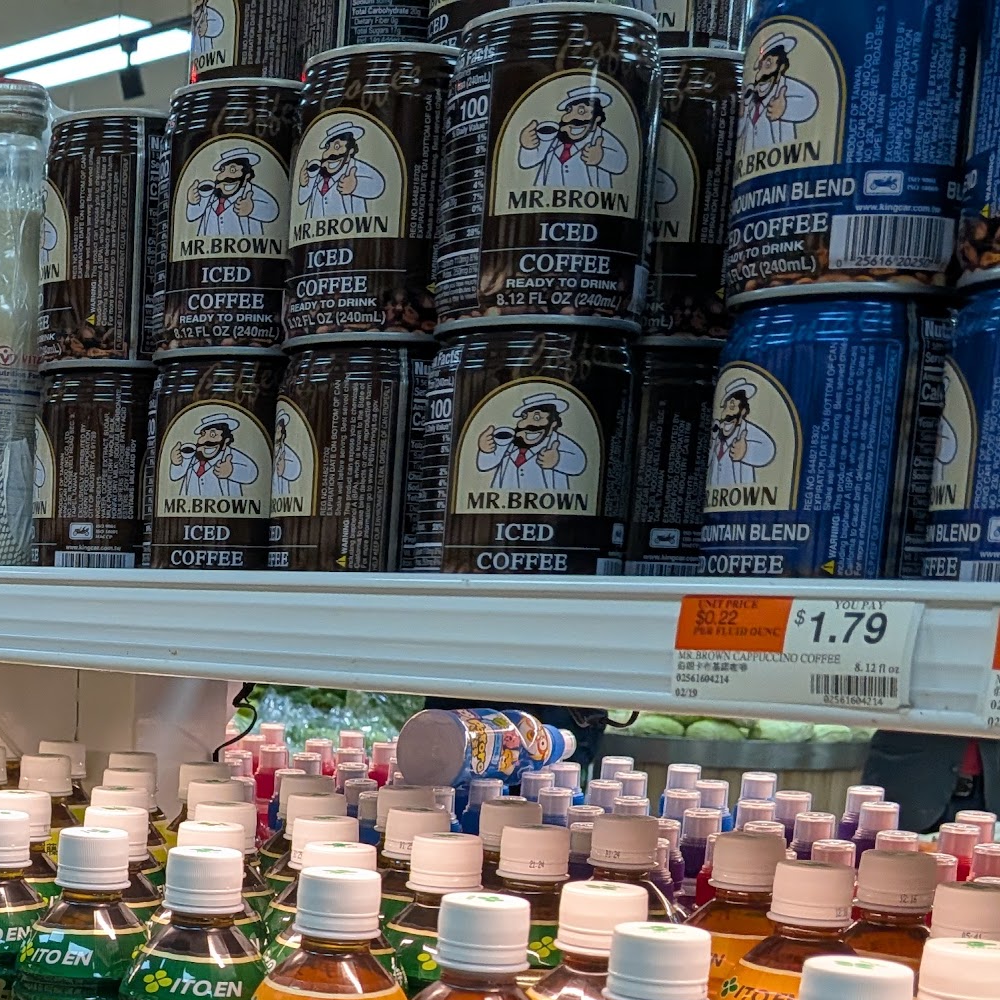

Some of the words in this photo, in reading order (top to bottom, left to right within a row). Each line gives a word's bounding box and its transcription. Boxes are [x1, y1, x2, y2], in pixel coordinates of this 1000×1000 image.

[460, 94, 488, 119] 100
[791, 177, 856, 200] BLEND
[508, 189, 630, 213] MR.BROWN
[293, 216, 388, 242] MR.BROWN
[539, 223, 599, 243] ICED
[743, 212, 829, 243] COFFEE
[179, 237, 283, 257] MR.BROWN
[745, 248, 760, 259] TO
[762, 240, 804, 255] DRINK
[307, 248, 354, 269] ICED
[519, 253, 611, 275] COFFEE
[200, 266, 251, 284] ICED
[742, 263, 758, 278] OZ
[296, 276, 368, 298] COFFEE
[506, 278, 554, 288] READY
[558, 279, 577, 288] TO
[580, 279, 618, 290] DRINK
[187, 292, 265, 310] COFFEE
[290, 301, 318, 313] READY
[320, 300, 335, 308] TO
[338, 298, 377, 307] DRINK
[496, 293, 524, 305] 8.12
[528, 293, 546, 305] FL
[551, 293, 572, 305] OZ
[179, 313, 211, 325] READY
[213, 313, 229, 324] TO
[232, 313, 273, 324] DRINK
[317, 312, 333, 325] OZ
[173, 326, 192, 339] 8.12
[194, 327, 209, 339] FL
[210, 327, 230, 339] OZ
[429, 397, 451, 419] 100
[164, 498, 262, 515] MR.BROWN
[466, 491, 589, 511] MR.BROWN
[183, 525, 231, 541] ICED
[495, 523, 554, 541] ICED
[749, 524, 810, 541] BLEND
[937, 524, 981, 542] BLEND
[170, 550, 244, 567] COFFEE
[476, 552, 568, 570] COFFEE
[709, 555, 784, 575] COFFEE
[834, 600, 858, 610] YOU
[861, 600, 887, 610] PAY
[695, 609, 738, 627] $0.22
[799, 653, 841, 664] COFFEE
[6, 926, 31, 942] EN
[30, 947, 60, 964] ITO
[61, 949, 94, 966] EN
[169, 977, 212, 997] ITO
[213, 980, 243, 998] EN
